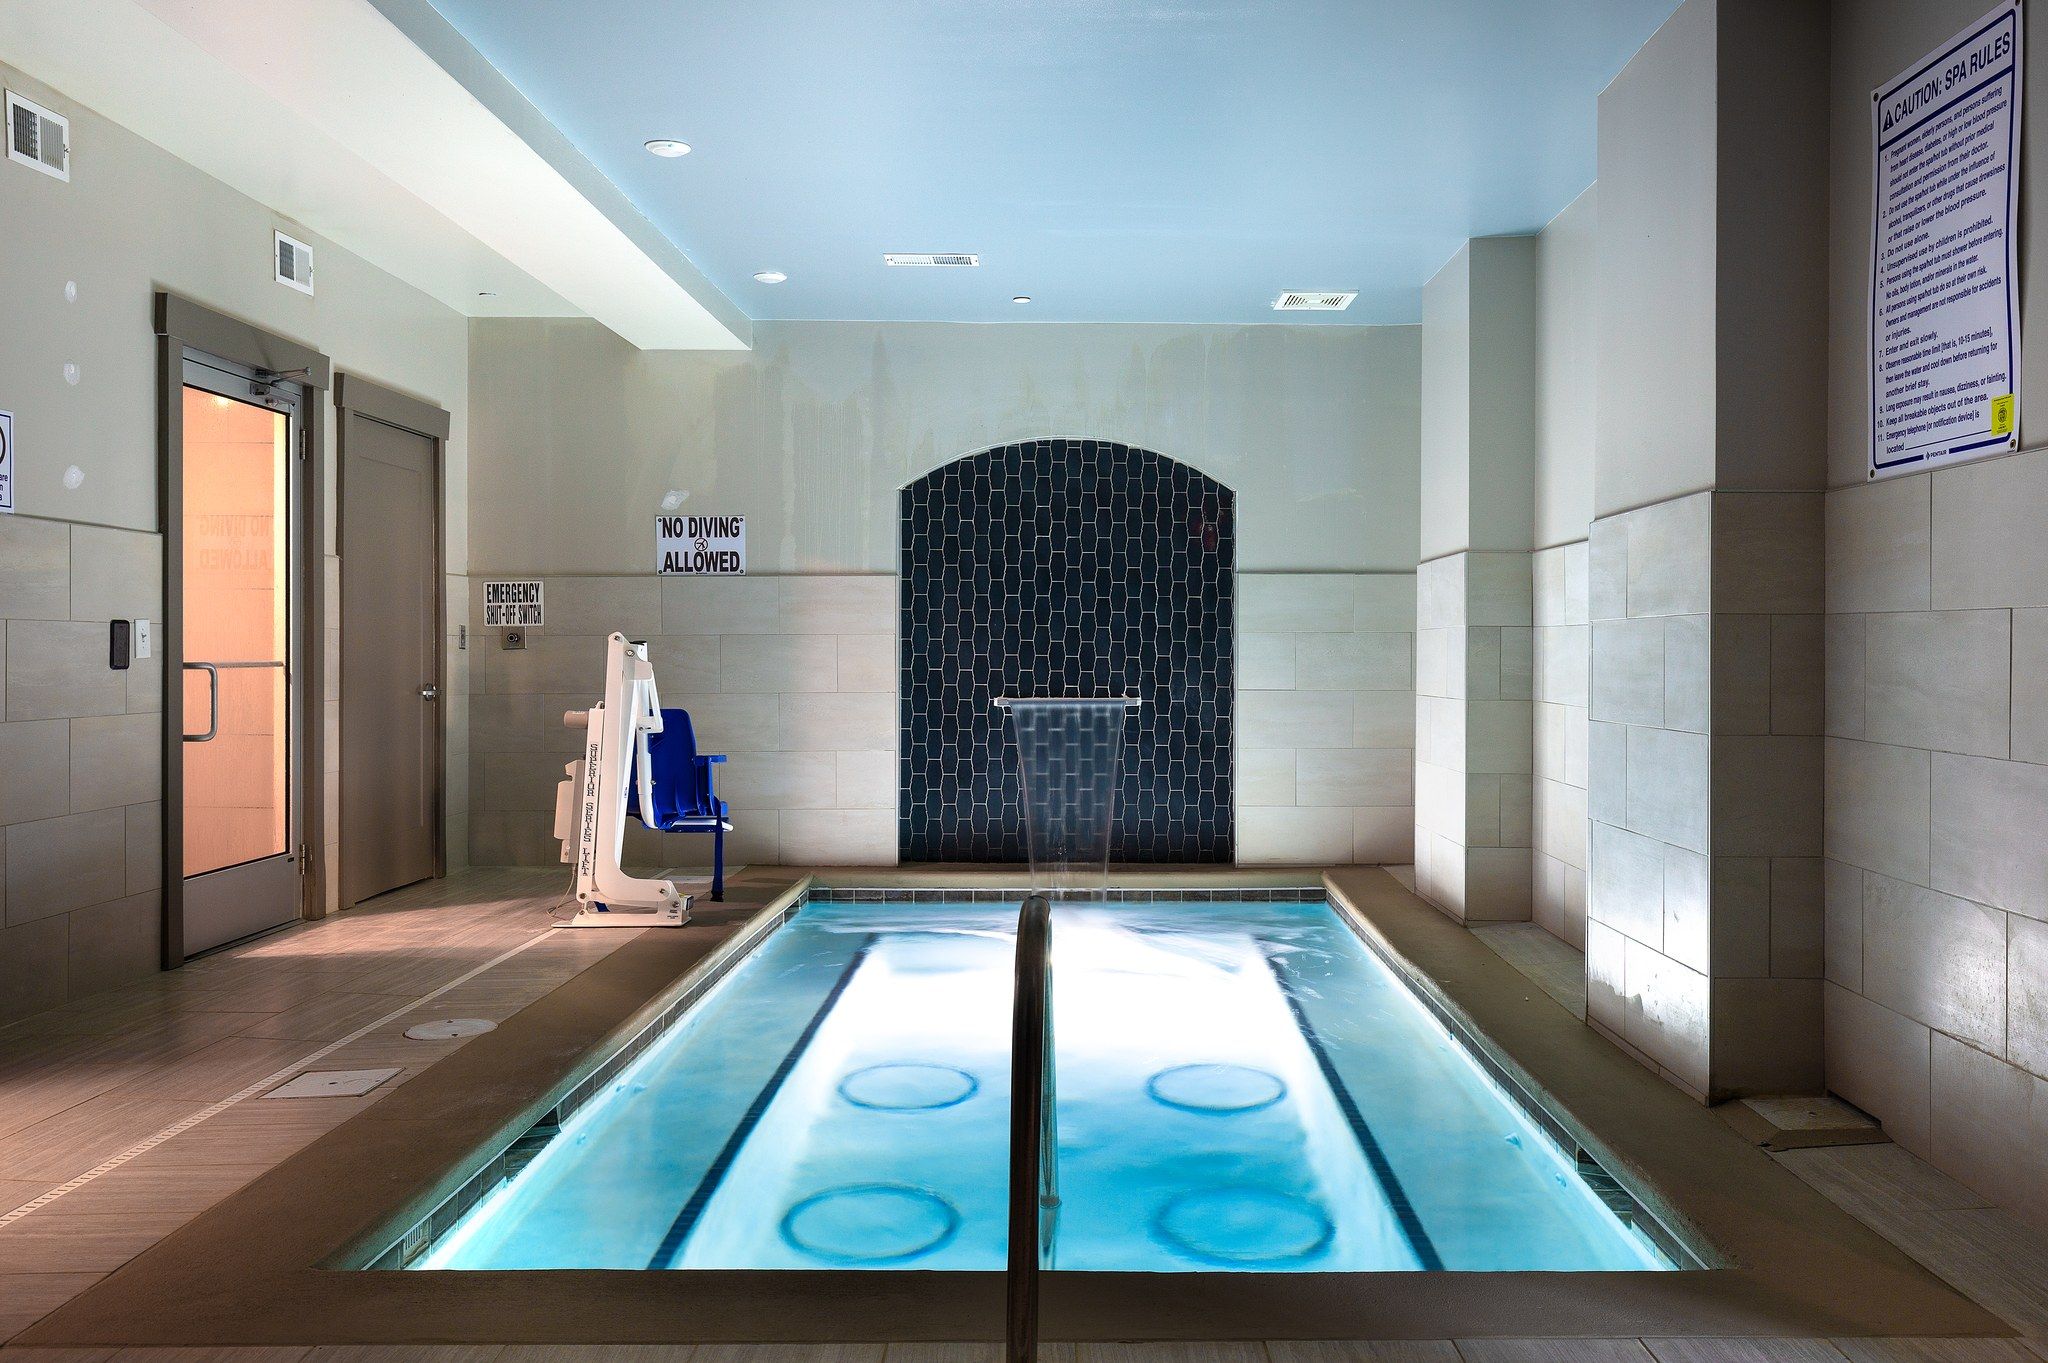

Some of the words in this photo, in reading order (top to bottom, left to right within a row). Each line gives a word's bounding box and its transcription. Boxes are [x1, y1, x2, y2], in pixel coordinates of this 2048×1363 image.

[1894, 78, 1942, 121] CAUTION:
[1945, 60, 1966, 90] SPA
[1970, 32, 2010, 74] RULES
[1953, 108, 1962, 120] and
[1962, 99, 1981, 117] persons
[1981, 86, 2002, 104] suffering
[1942, 133, 1947, 142] or
[1947, 126, 1957, 138] high
[1958, 124, 1963, 133] or
[1963, 119, 1972, 129] low
[1972, 109, 1985, 124] blood
[1986, 99, 2007, 119] pressure
[1909, 165, 1918, 175] enter
[1948, 138, 1964, 153] without
[1964, 132, 1975, 146] prior
[1976, 120, 1994, 137] medical
[1914, 175, 1922, 187] and
[1922, 163, 1947, 184] permission
[1947, 157, 1958, 168] from
[1959, 149, 1970, 162] their
[1971, 141, 1988, 155] doctor.
[1926, 201, 1931, 209] or
[1931, 195, 1942, 206] other
[1943, 188, 1955, 200] drugs
[1955, 182, 1964, 194] that
[1965, 177, 1978, 189] cause
[1978, 163, 2005, 182] drowsiness
[1936, 177, 1947, 189] while
[1948, 171, 1960, 183] under
[1960, 166, 1968, 176] the
[1968, 156, 1989, 172] influence
[1990, 150, 1995, 161] of
[1887, 235, 1893, 243] or
[1893, 229, 1902, 240] that
[1903, 224, 1914, 235] raise
[1915, 221, 1920, 229] or
[1921, 214, 1934, 226] lower
[1935, 209, 1944, 219] the
[1944, 199, 1960, 214] blood
[1960, 189, 1986, 208] pressure.
[1879, 280, 1884, 288] 5.
[1901, 268, 1912, 279] using
[1941, 249, 1951, 261] must
[1952, 243, 1967, 256] shower
[1968, 237, 1982, 249] before
[1983, 228, 2003, 242] entering.
[1880, 252, 1885, 261] 3.
[1887, 248, 1894, 257] Do
[1895, 243, 1903, 254] not
[1904, 239, 1913, 249] use
[1914, 232, 1929, 244] alone.
[1886, 250, 1918, 271] Unsupervised
[1918, 246, 1927, 256] use
[1928, 243, 1934, 252] by
[1935, 233, 1956, 248] children
[1957, 230, 1962, 239] is
[1963, 215, 1993, 237] prohibited.
[1879, 308, 1883, 316] 6.
[1891, 300, 1906, 312] persons
[1906, 295, 1917, 305] using
[1939, 282, 1945, 291] do
[1945, 281, 1951, 289] so
[1951, 277, 1956, 287] at
[1956, 273, 1966, 284] their
[1899, 283, 1909, 294] body
[1935, 264, 1952, 278] minerals
[1907, 303, 1931, 319] management
[1938, 296, 1946, 307] not
[1946, 287, 1971, 303] responsible
[1979, 276, 2001, 291] accidents
[1878, 349, 1884, 357] 7.
[1885, 345, 1898, 355] Enter
[1899, 340, 1909, 350] and
[1909, 336, 1919, 347] exit
[1885, 334, 1891, 342] or
[1891, 327, 1911, 340] injuries.
[1931, 343, 1940, 354] limit
[1958, 333, 1970, 345] 10-15
[1911, 366, 1921, 375] water
[1922, 362, 1930, 372] and
[1930, 359, 1939, 369] cool
[1940, 356, 1952, 366] down
[1952, 352, 1967, 362] before
[1967, 345, 1989, 357] returning
[1885, 386, 1904, 397] another
[1904, 380, 1917, 392] brief
[1917, 379, 1929, 388] stay.
[1885, 403, 1895, 412] Long
[1895, 398, 1913, 410] exposure
[1922, 390, 1934, 401] result
[1980, 377, 1986, 386] or
[1986, 372, 2007, 384] fainting.
[1885, 417, 1897, 426] Keep
[1904, 408, 1927, 421] breakable
[1927, 403, 1946, 415] objects
[1947, 400, 1956, 410] out
[1957, 397, 1963, 407] of
[1964, 396, 1973, 405] the
[1974, 393, 1988, 403] area.
[1886, 429, 1906, 440] Emergency
[1933, 416, 1957, 428] notification
[1957, 410, 1974, 422] device]
[1974, 409, 1979, 418] is
[1886, 442, 1904, 454] located
[662, 517, 683, 538] NO
[688, 517, 740, 538] DIVING
[663, 551, 740, 572] ALLOWED
[487, 583, 540, 603] EMERGENCY
[487, 605, 516, 625] SHUT-OFF
[518, 604, 541, 624] SWITCH
[587, 744, 598, 797] SUPERIOR
[583, 802, 594, 843] SERIES
[582, 847, 591, 877] LIFT
